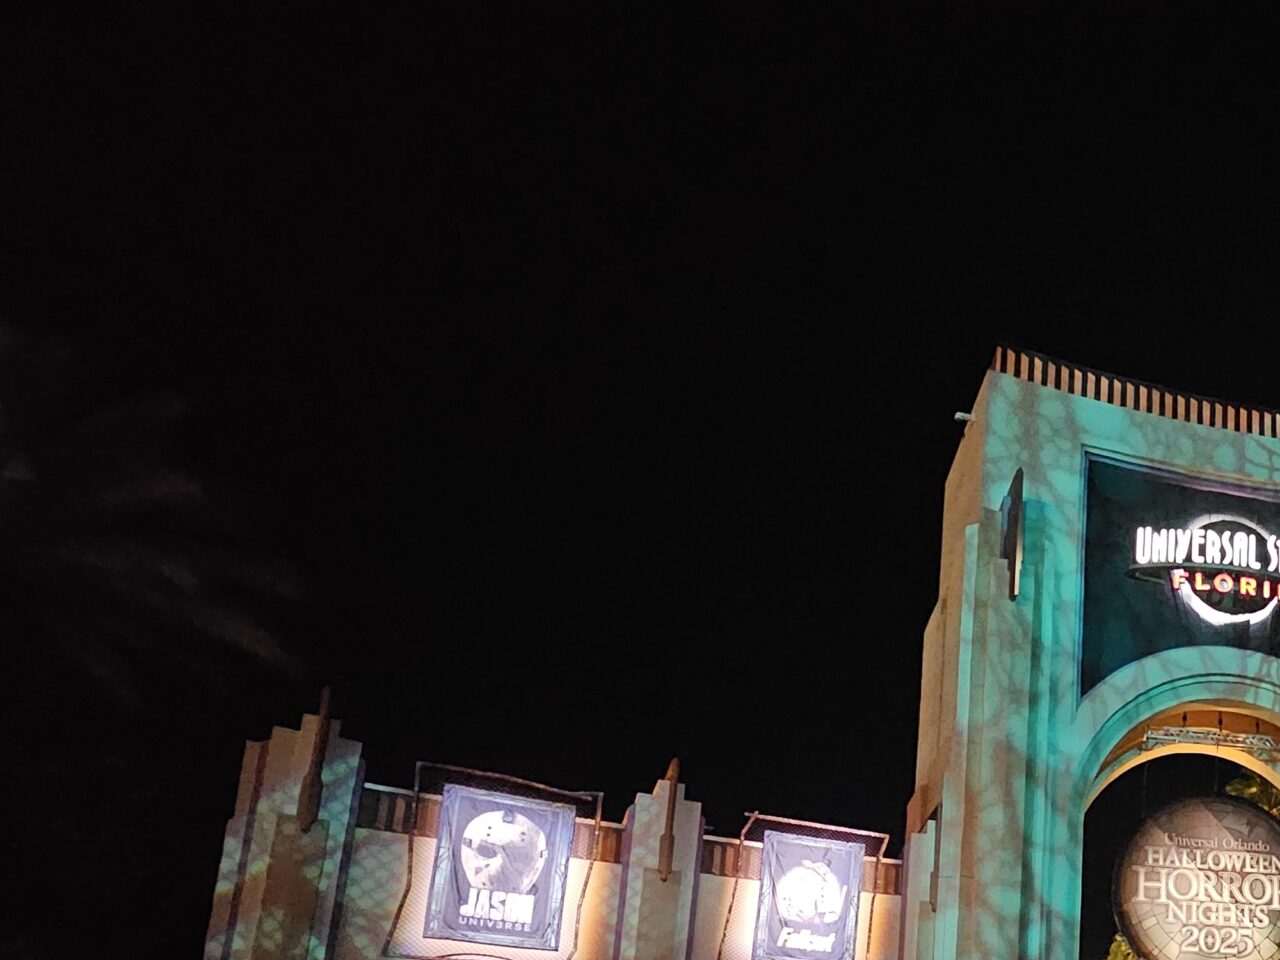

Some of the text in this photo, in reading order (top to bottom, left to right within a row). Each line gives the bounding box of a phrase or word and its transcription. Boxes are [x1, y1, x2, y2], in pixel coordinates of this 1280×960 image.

[1135, 526, 1261, 569] UNIVERSAL
[1164, 832, 1270, 852] Universal Orlando
[1165, 900, 1270, 928] NIGHTS
[1180, 925, 1256, 958] 2025
